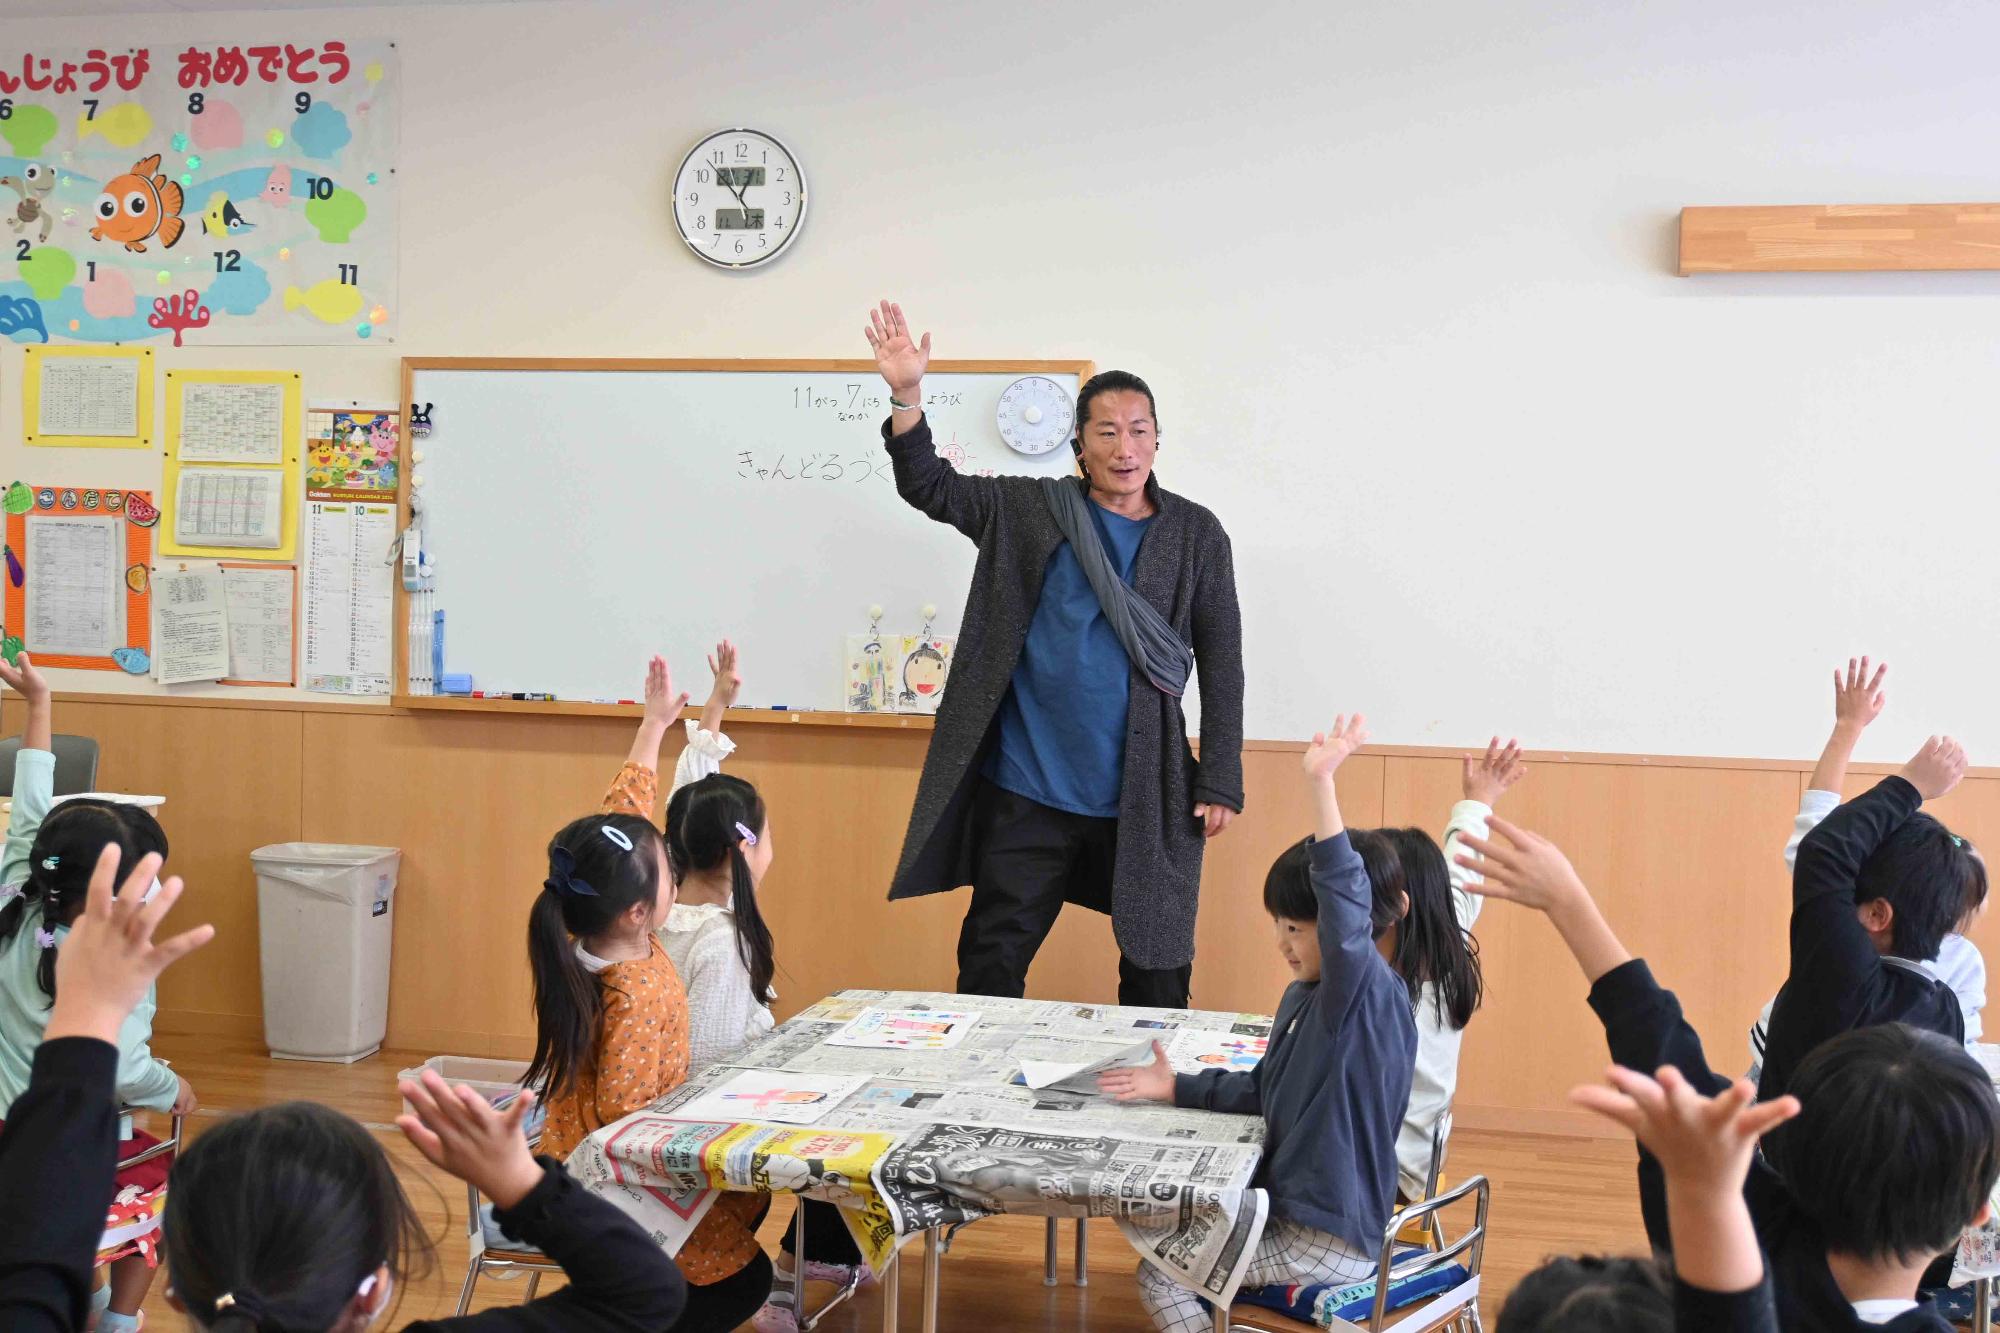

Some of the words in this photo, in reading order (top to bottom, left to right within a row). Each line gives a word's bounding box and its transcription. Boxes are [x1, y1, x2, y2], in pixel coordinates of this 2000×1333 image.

[177, 41, 351, 89] おめでとう
[0, 98, 13, 120] 6
[188, 92, 205, 115] 8
[295, 91, 311, 114] 9
[83, 100, 99, 121] 7
[713, 150, 724, 164] 11
[735, 143, 748, 158] 12
[762, 151, 766, 164] 1
[696, 169, 709, 183] 10
[776, 167, 784, 182] 2
[306, 176, 334, 200] 10
[690, 192, 699, 206] 9
[783, 191, 791, 206] 3
[697, 215, 706, 229] 8
[774, 216, 783, 229] 4
[714, 234, 721, 247] 7
[735, 239, 743, 254] 6
[758, 234, 766, 247] 5
[15, 239, 32, 262] 2
[213, 249, 242, 273] 12
[87, 261, 96, 282] 1
[337, 263, 358, 286] 11
[838, 412, 869, 422] なのか
[39, 489, 121, 510] こんだて
[312, 504, 321, 514] 11
[354, 505, 365, 516] 10
